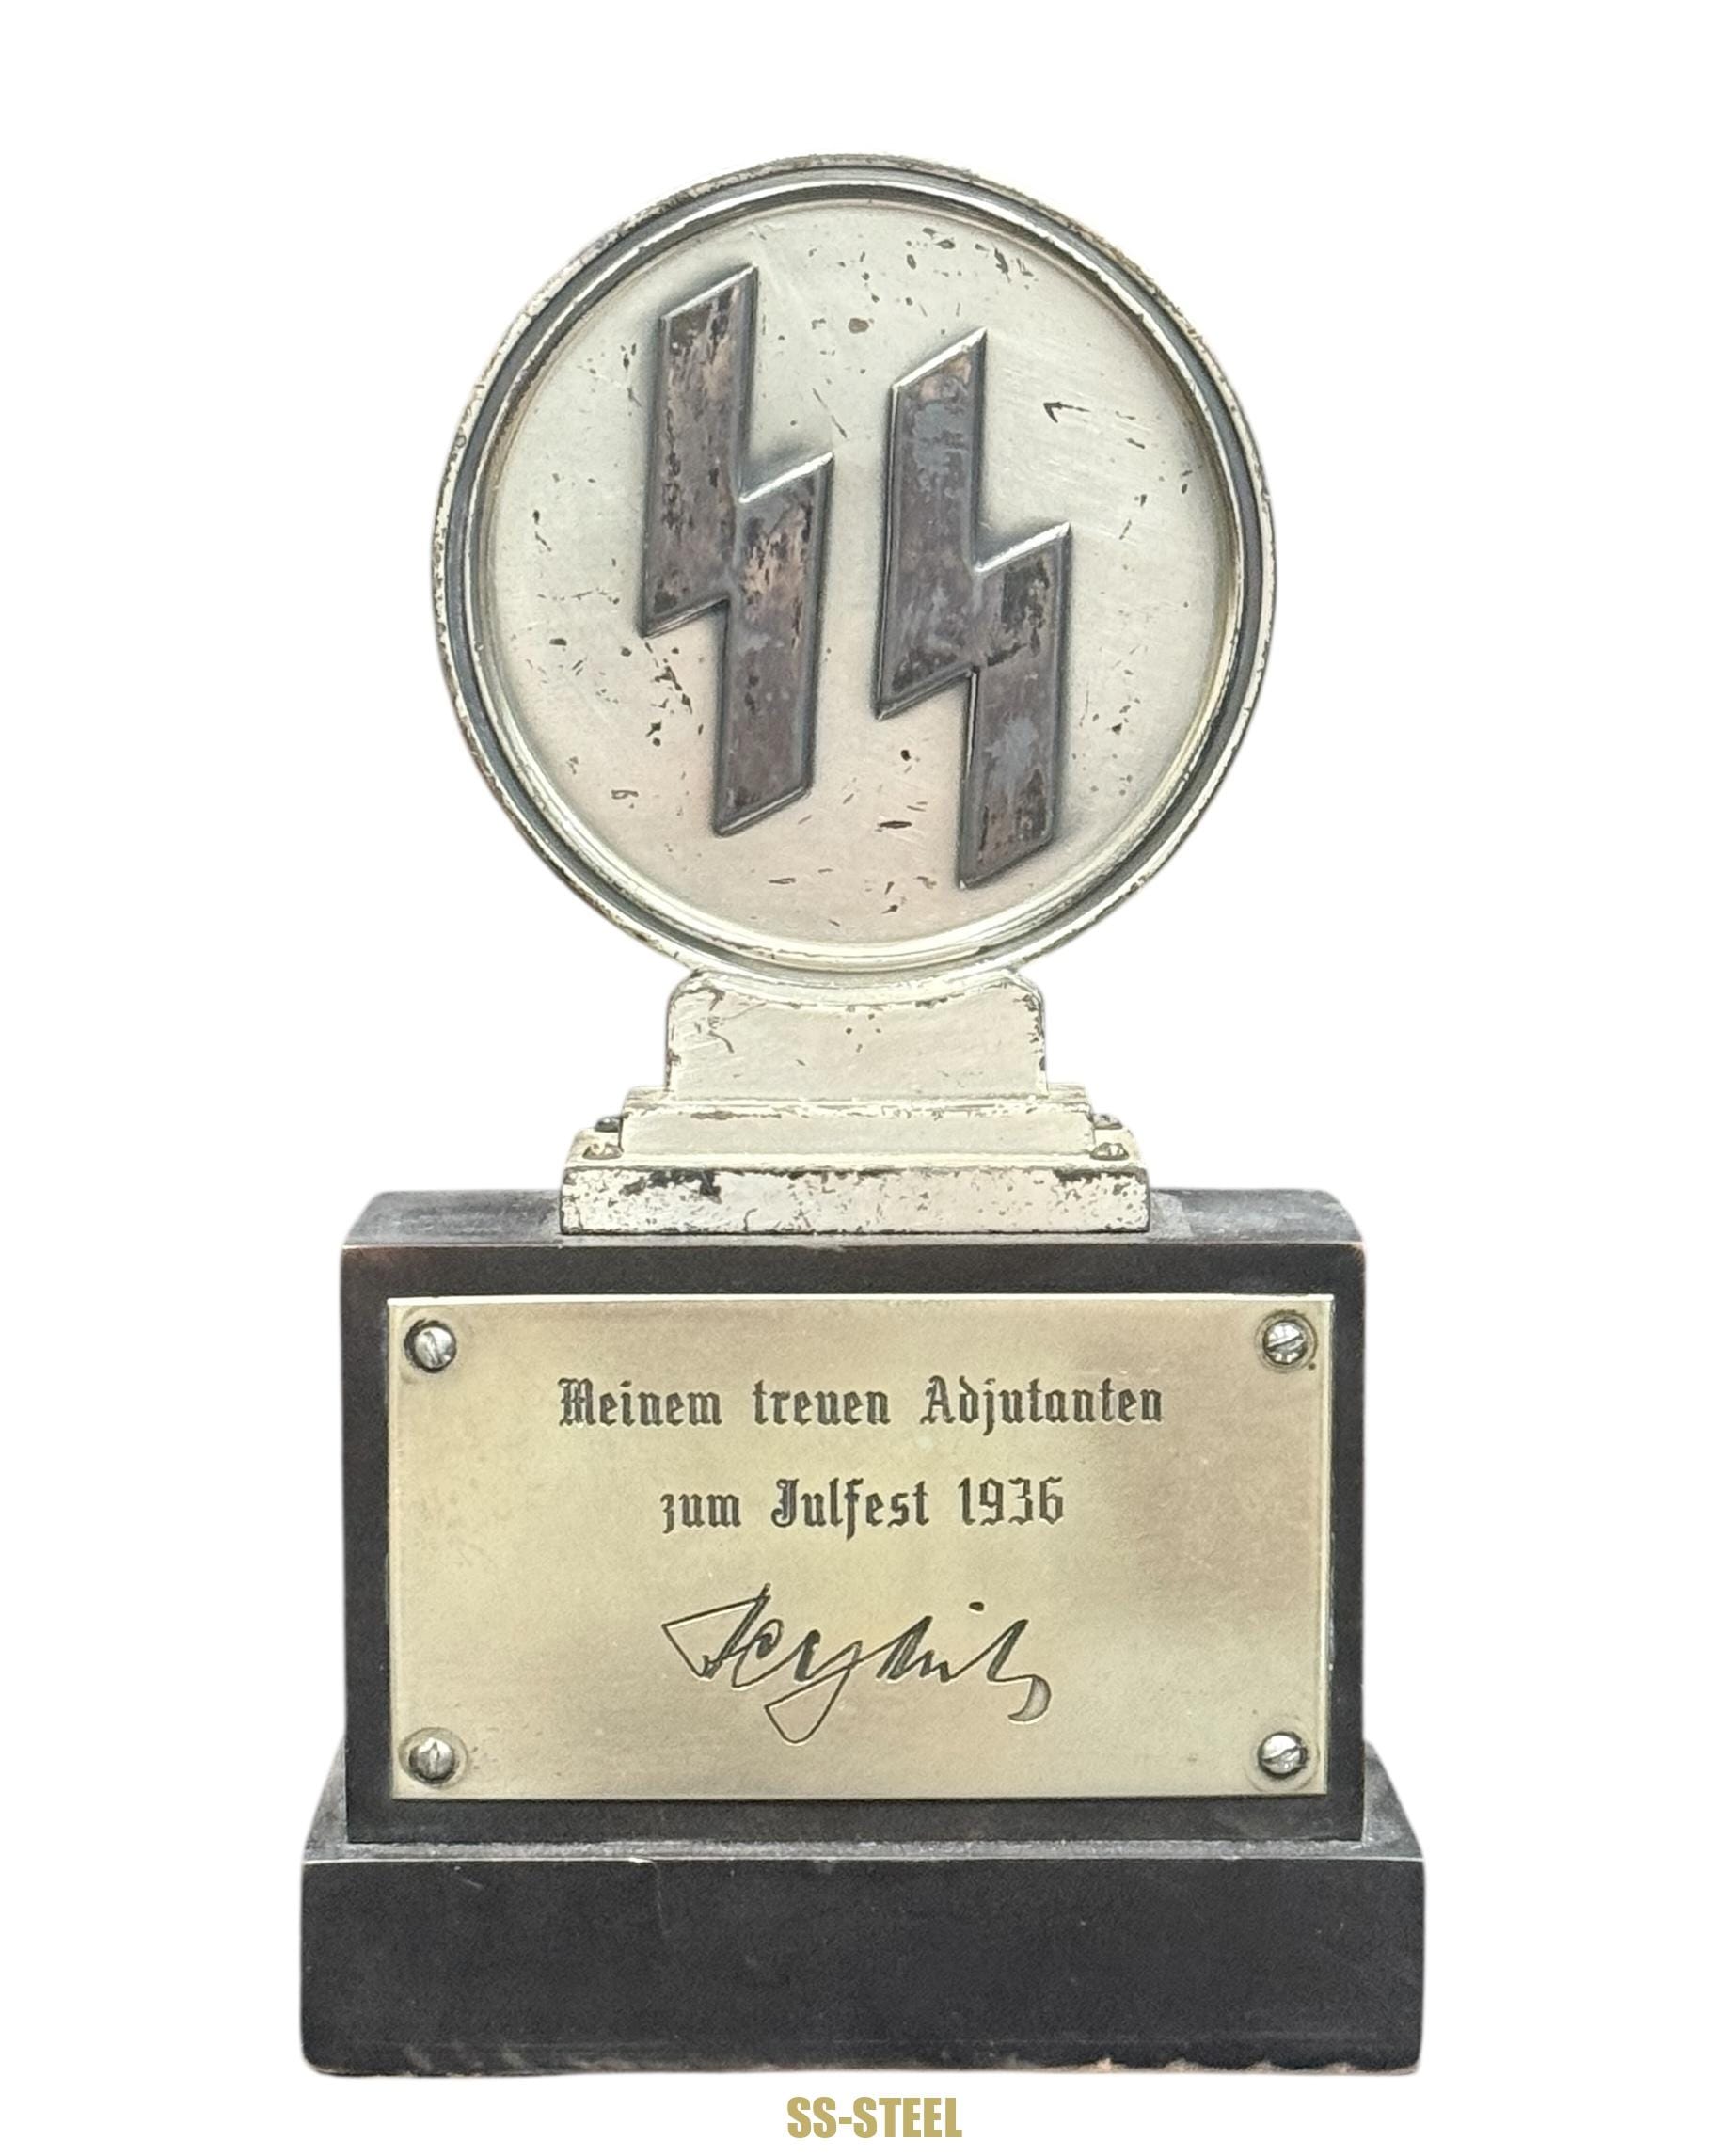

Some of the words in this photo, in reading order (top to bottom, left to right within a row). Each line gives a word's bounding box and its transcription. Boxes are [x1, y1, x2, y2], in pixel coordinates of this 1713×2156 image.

[558, 1377, 722, 1427] Meinem
[753, 1379, 891, 1426] treuen
[919, 1374, 1163, 1436] Adjutanten
[660, 1492, 742, 1535] zum
[770, 1477, 930, 1541] Julfest
[958, 1476, 1065, 1527] 1936
